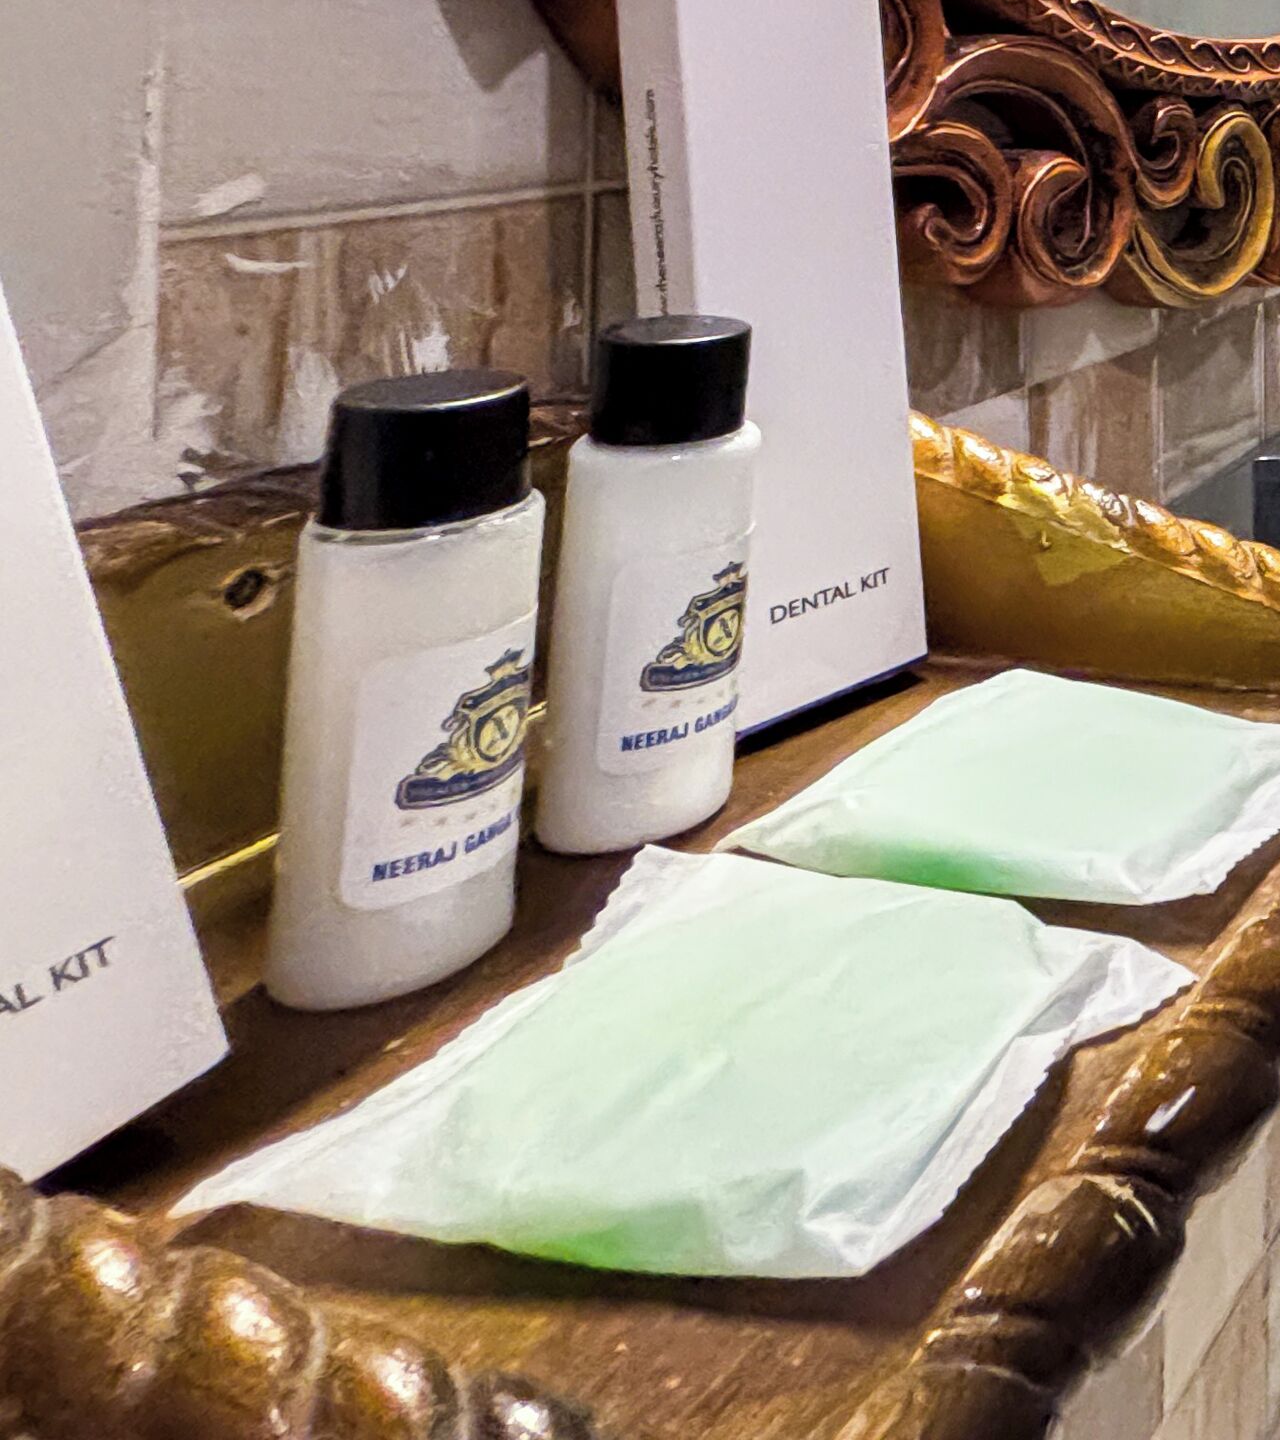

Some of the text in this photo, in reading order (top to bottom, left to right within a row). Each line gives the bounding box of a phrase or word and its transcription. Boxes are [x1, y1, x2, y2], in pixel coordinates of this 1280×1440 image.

[769, 567, 890, 625] DENTAL KIT
[621, 722, 690, 752] NEERAJ
[371, 841, 458, 882] NEERAJ
[48, 935, 116, 992] KIT
